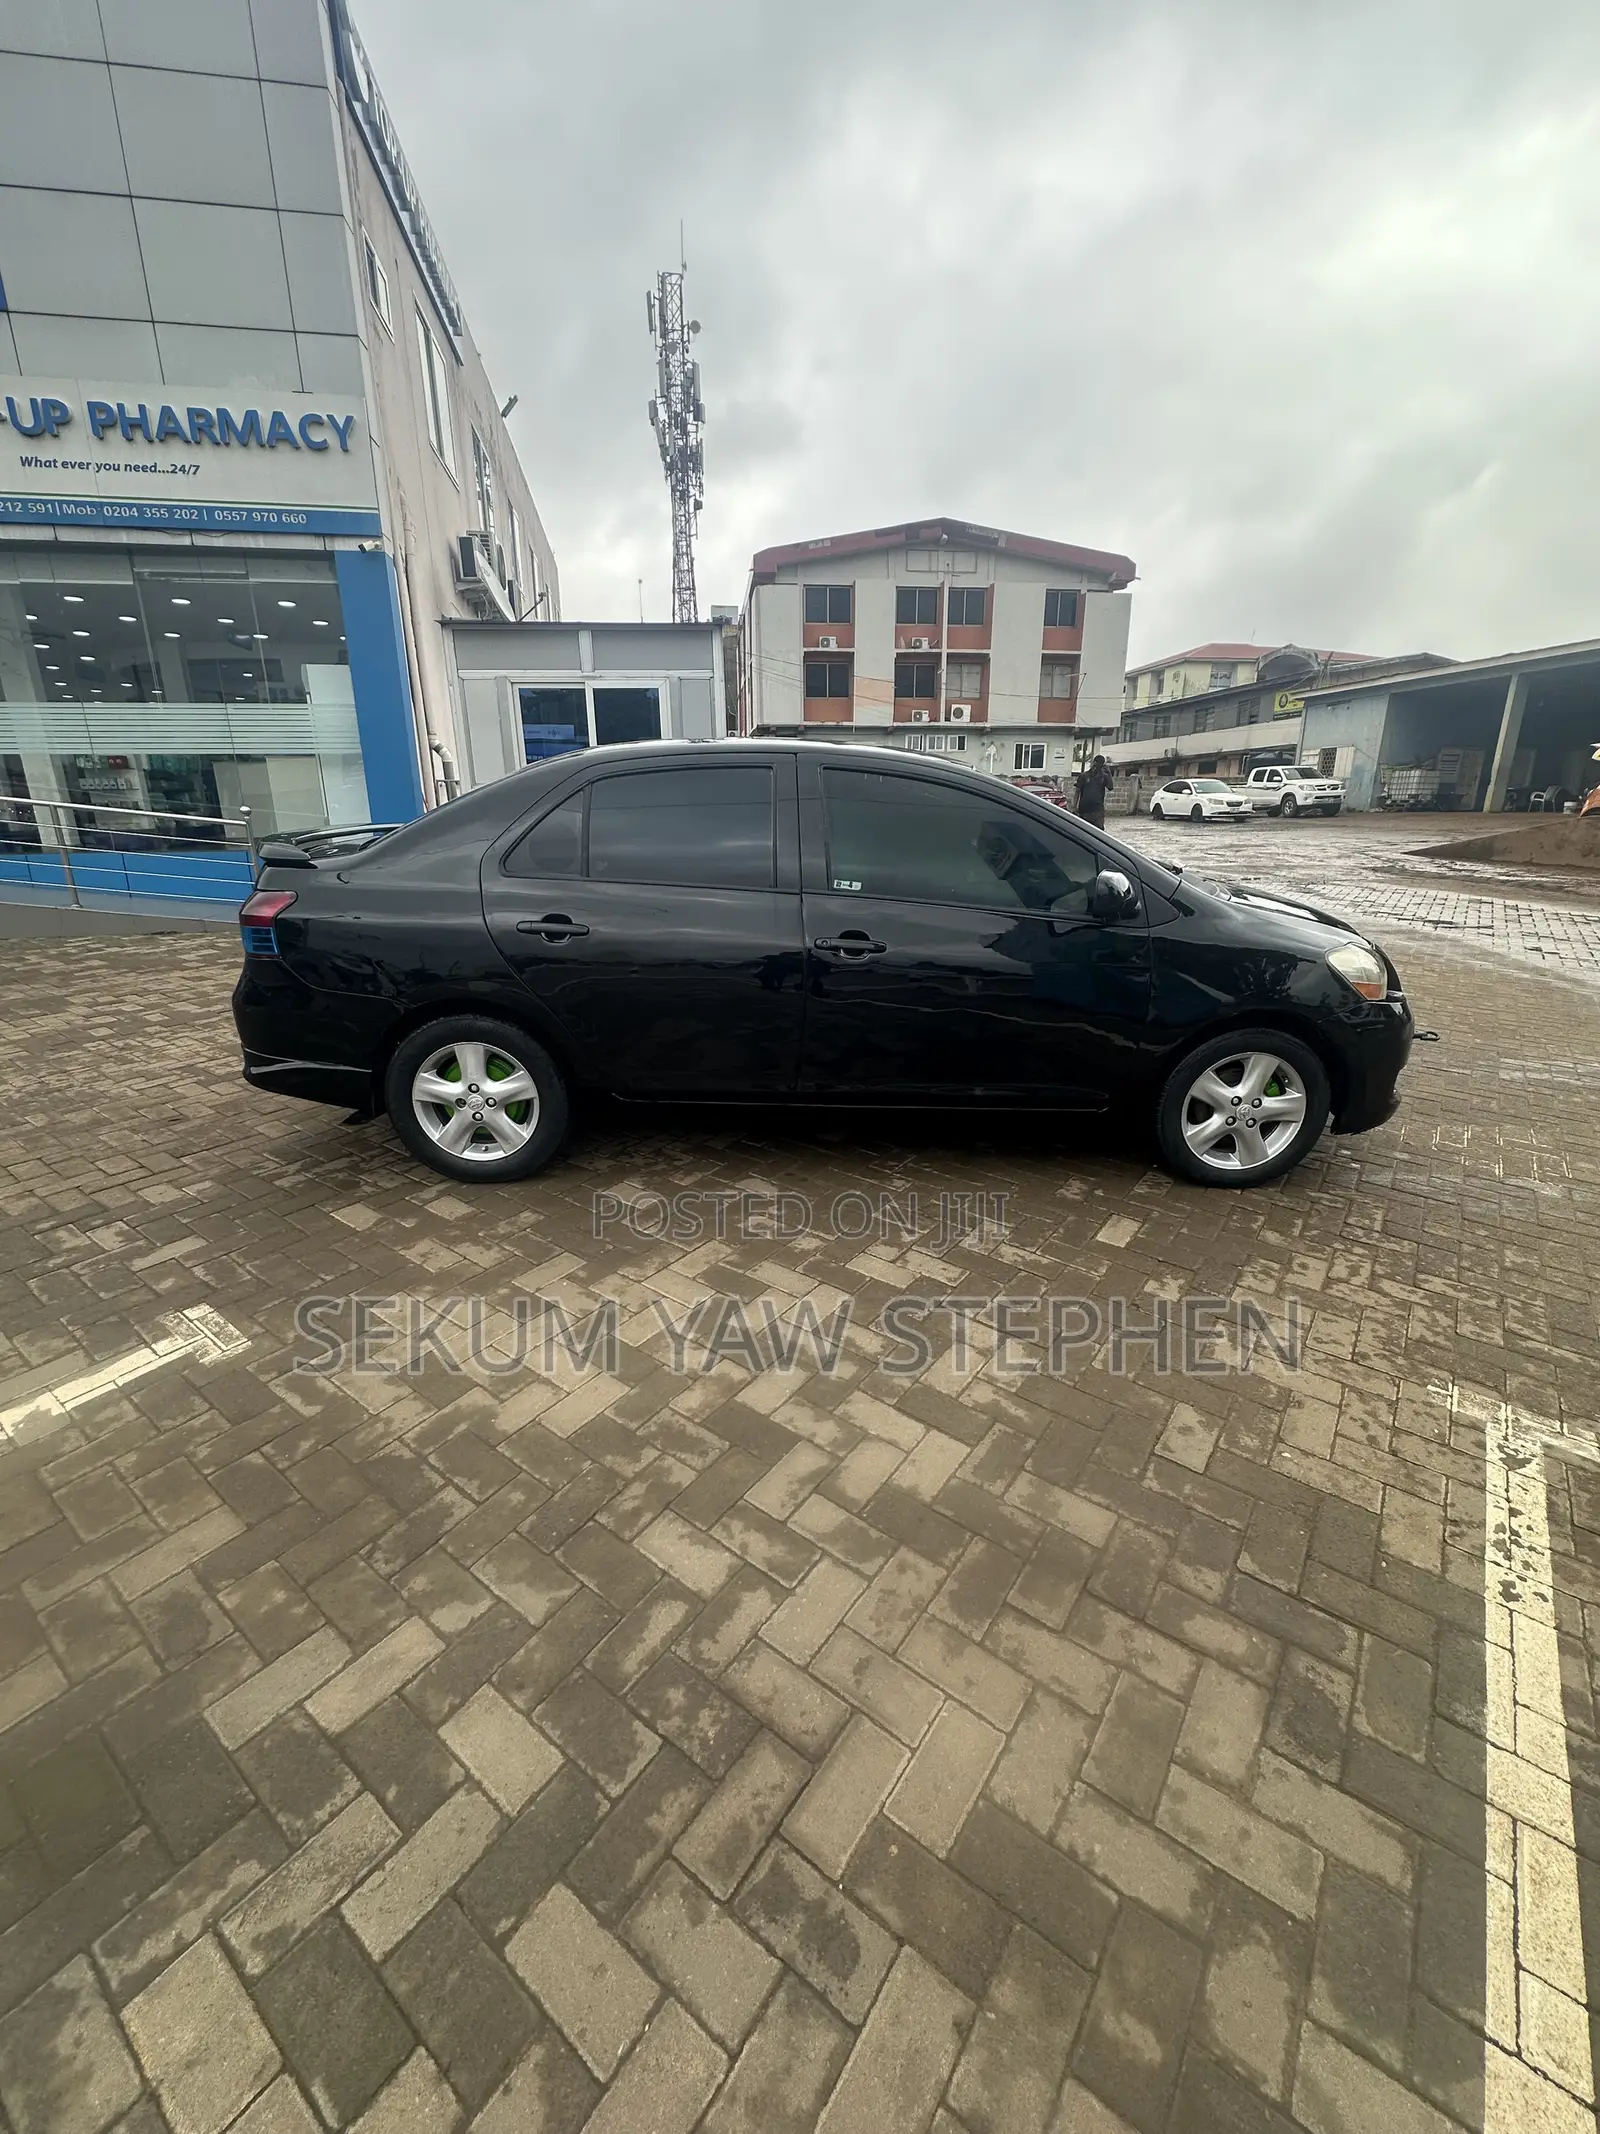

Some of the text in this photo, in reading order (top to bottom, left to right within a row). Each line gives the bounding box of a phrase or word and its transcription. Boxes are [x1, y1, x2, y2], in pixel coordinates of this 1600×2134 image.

[87, 400, 355, 453] PHARMACY
[20, 455, 58, 469] What
[61, 459, 91, 471] ever
[95, 462, 120, 473] you
[103, 505, 138, 517] 0204
[143, 507, 169, 518] 355
[173, 508, 199, 520] 202
[214, 510, 248, 521] 0557
[252, 511, 278, 523] 970
[281, 513, 307, 524] 660
